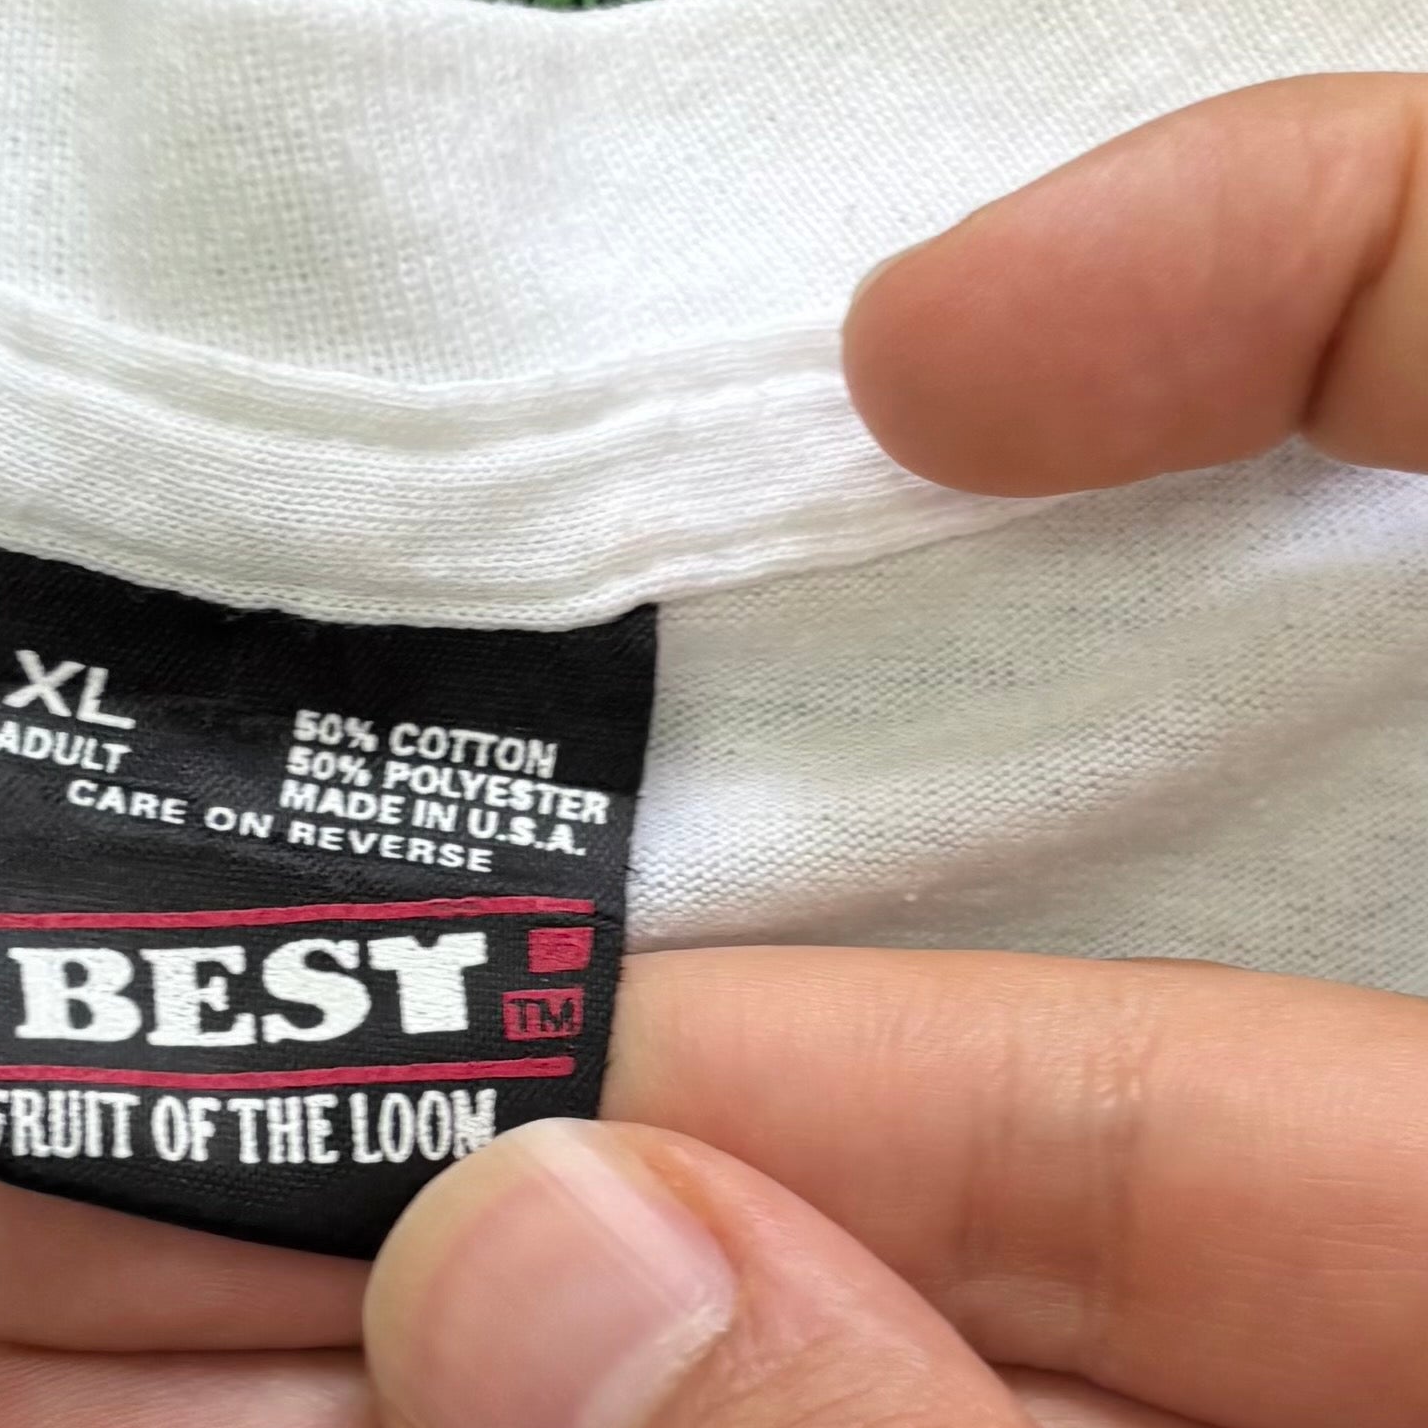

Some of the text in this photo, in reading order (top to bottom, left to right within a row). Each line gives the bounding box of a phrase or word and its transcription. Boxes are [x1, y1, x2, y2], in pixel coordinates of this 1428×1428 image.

[2, 650, 135, 729] XL
[294, 708, 557, 779] 50% COTTON
[279, 779, 587, 856] MADE IN U.S.A.
[286, 746, 609, 824] 50% POLYESTER
[66, 780, 493, 872] CARE ON REVERSE
[7, 932, 488, 1046] BEST
[514, 999, 573, 1034] TM
[151, 1094, 220, 1162] OF
[227, 1094, 339, 1164] THE
[351, 1088, 498, 1164] LOOM
